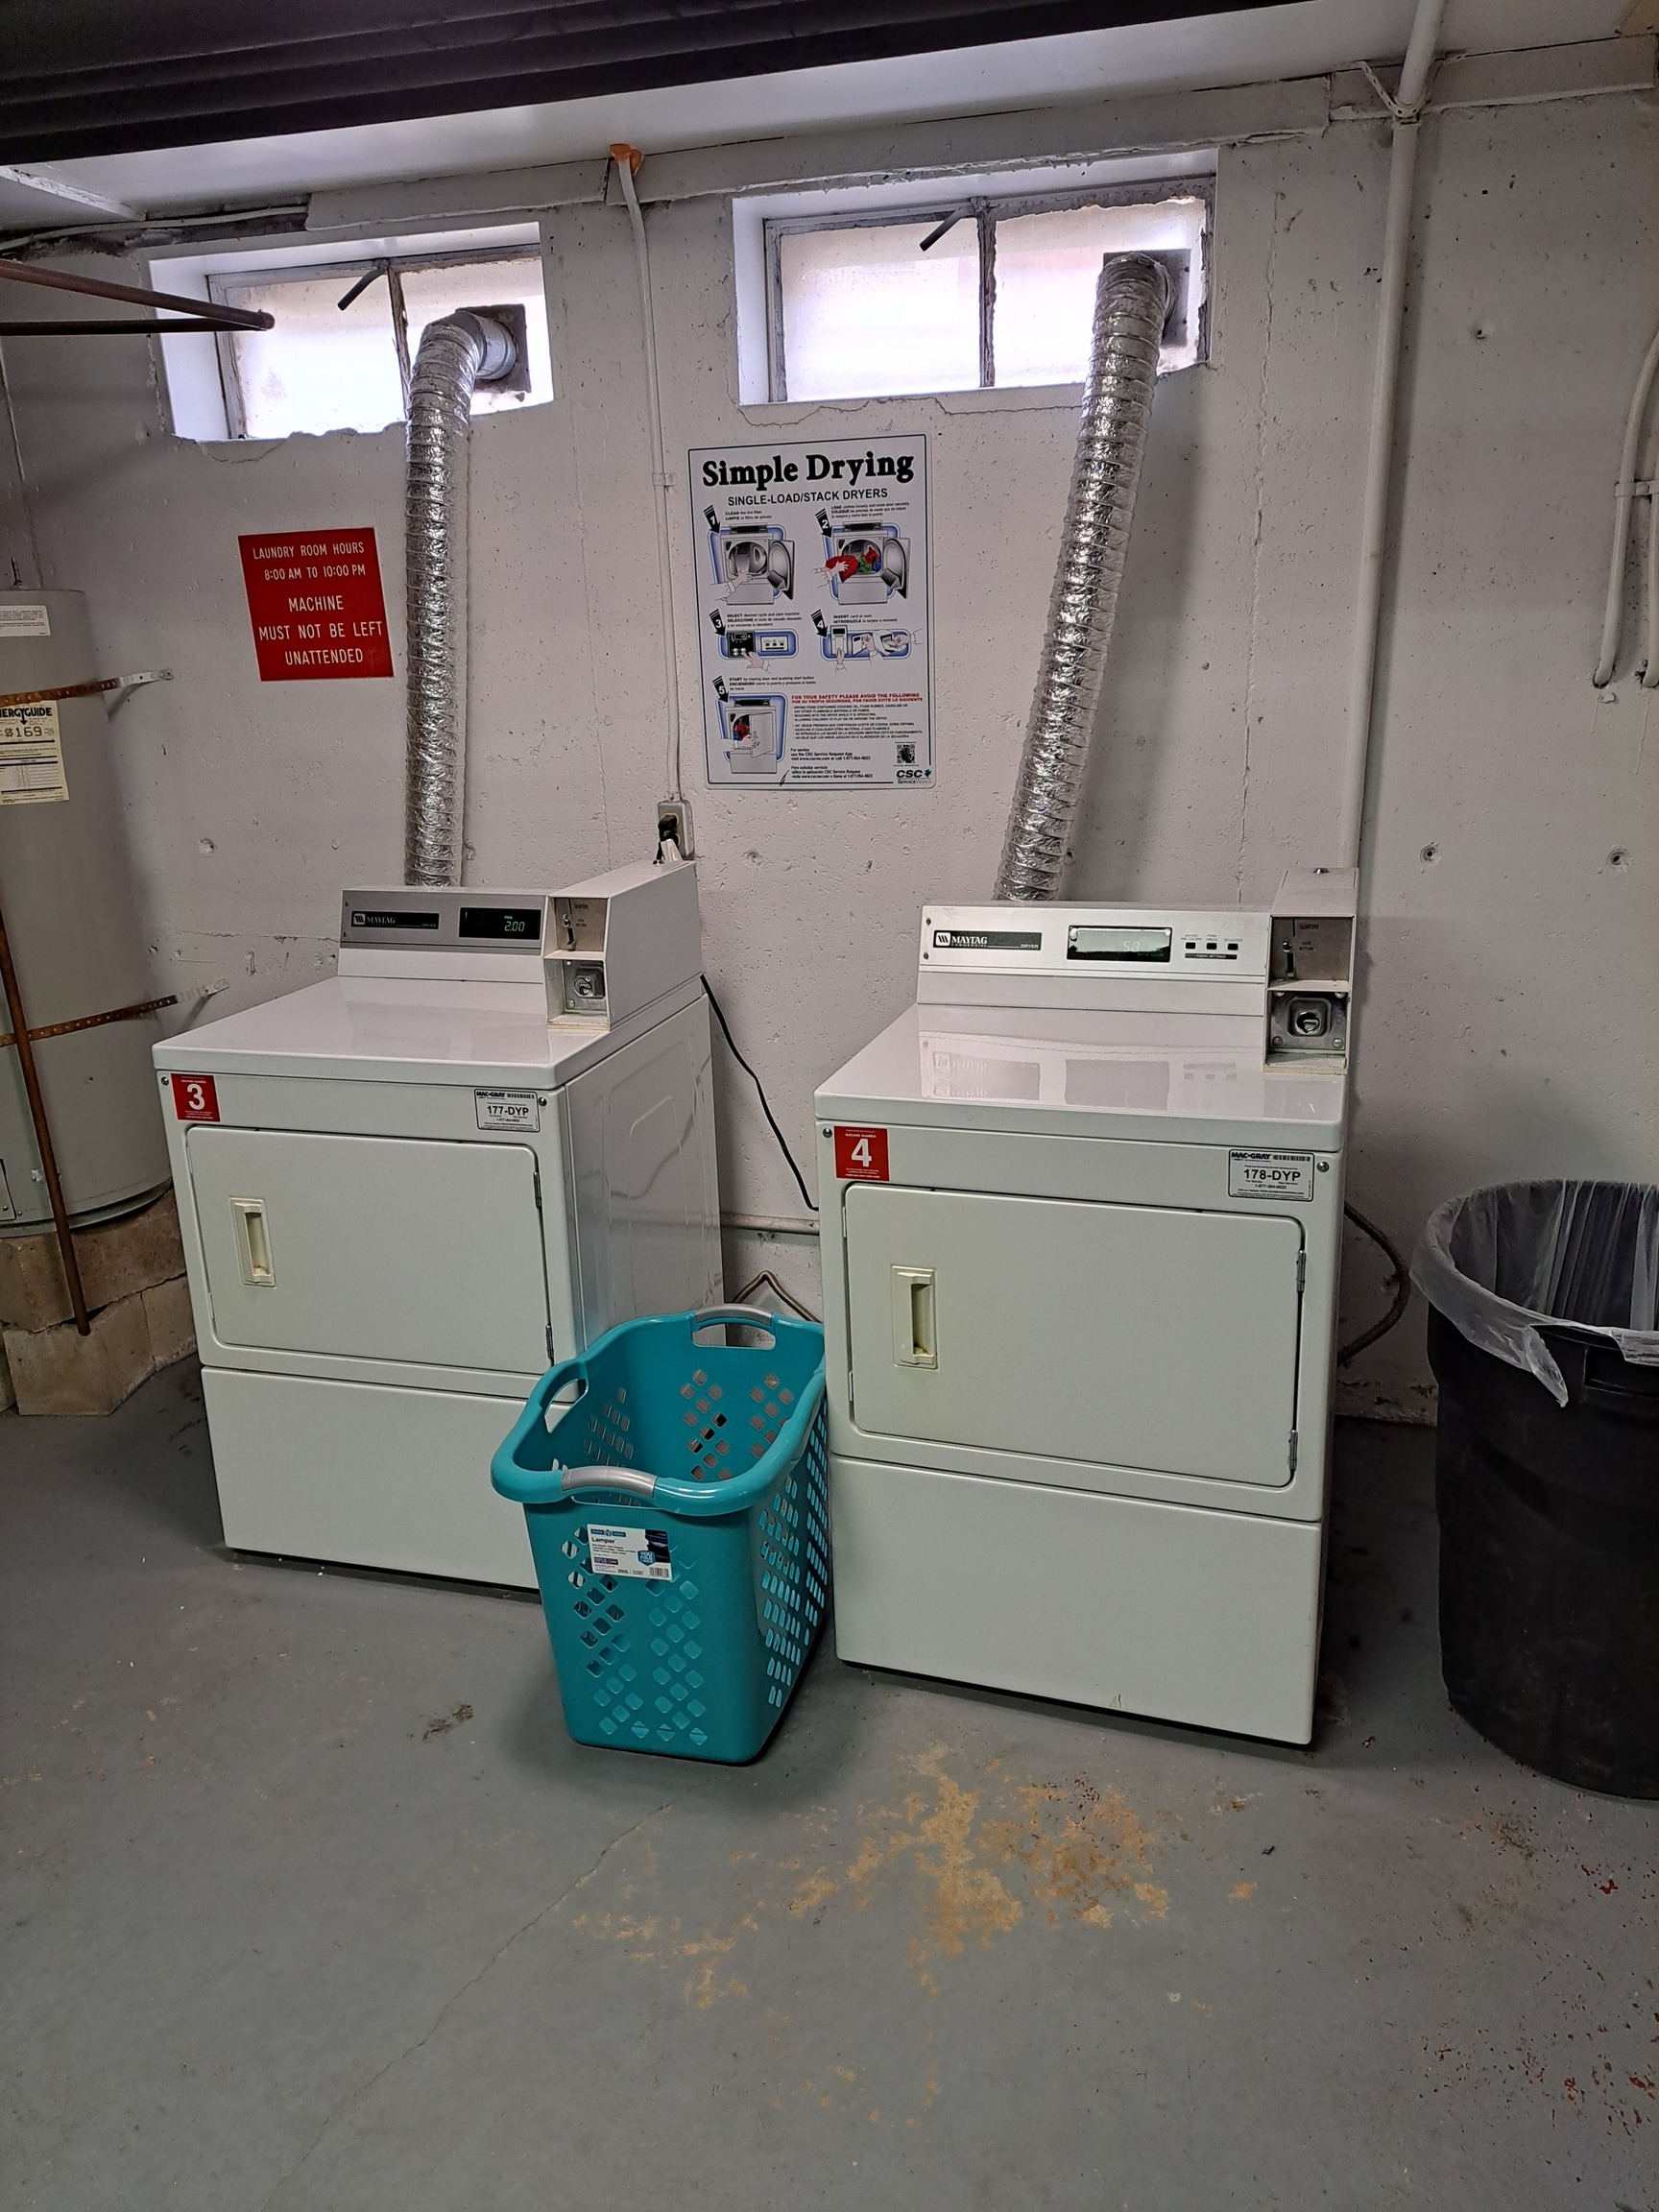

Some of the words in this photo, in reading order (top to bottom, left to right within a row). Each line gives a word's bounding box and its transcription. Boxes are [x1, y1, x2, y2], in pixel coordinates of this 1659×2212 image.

[703, 455, 799, 491] Simple
[805, 450, 914, 486] Drying
[728, 491, 840, 506] SINGLE-LOAD/STACK
[843, 488, 889, 500] DRYERS
[710, 516, 715, 525] 1
[823, 519, 829, 529] 2
[253, 546, 295, 560] LAUNDRY
[301, 544, 327, 556] ROOM
[333, 542, 365, 555] HOURS
[264, 568, 285, 581] 8:00
[289, 567, 302, 580] AM
[306, 566, 318, 578] TO
[324, 565, 349, 577] 10:00
[352, 564, 366, 575] PM
[288, 595, 344, 612] MACHINE
[715, 618, 721, 628] 3
[817, 620, 824, 629] 4
[259, 625, 290, 640] MUST
[299, 624, 321, 638] NOT
[329, 623, 346, 637] BE
[353, 621, 383, 637] LEFT
[285, 648, 364, 665] UNATTENDED
[719, 685, 725, 694] 5
[5, 726, 42, 737] $169
[896, 769, 923, 778] CSC
[504, 921, 525, 931] 2.00
[951, 935, 988, 945] MAYTAG
[186, 1083, 204, 1110] 3
[487, 1105, 529, 1116] 177-DYP
[851, 1138, 872, 1167] 4
[1243, 1168, 1301, 1182] 178-DYP
